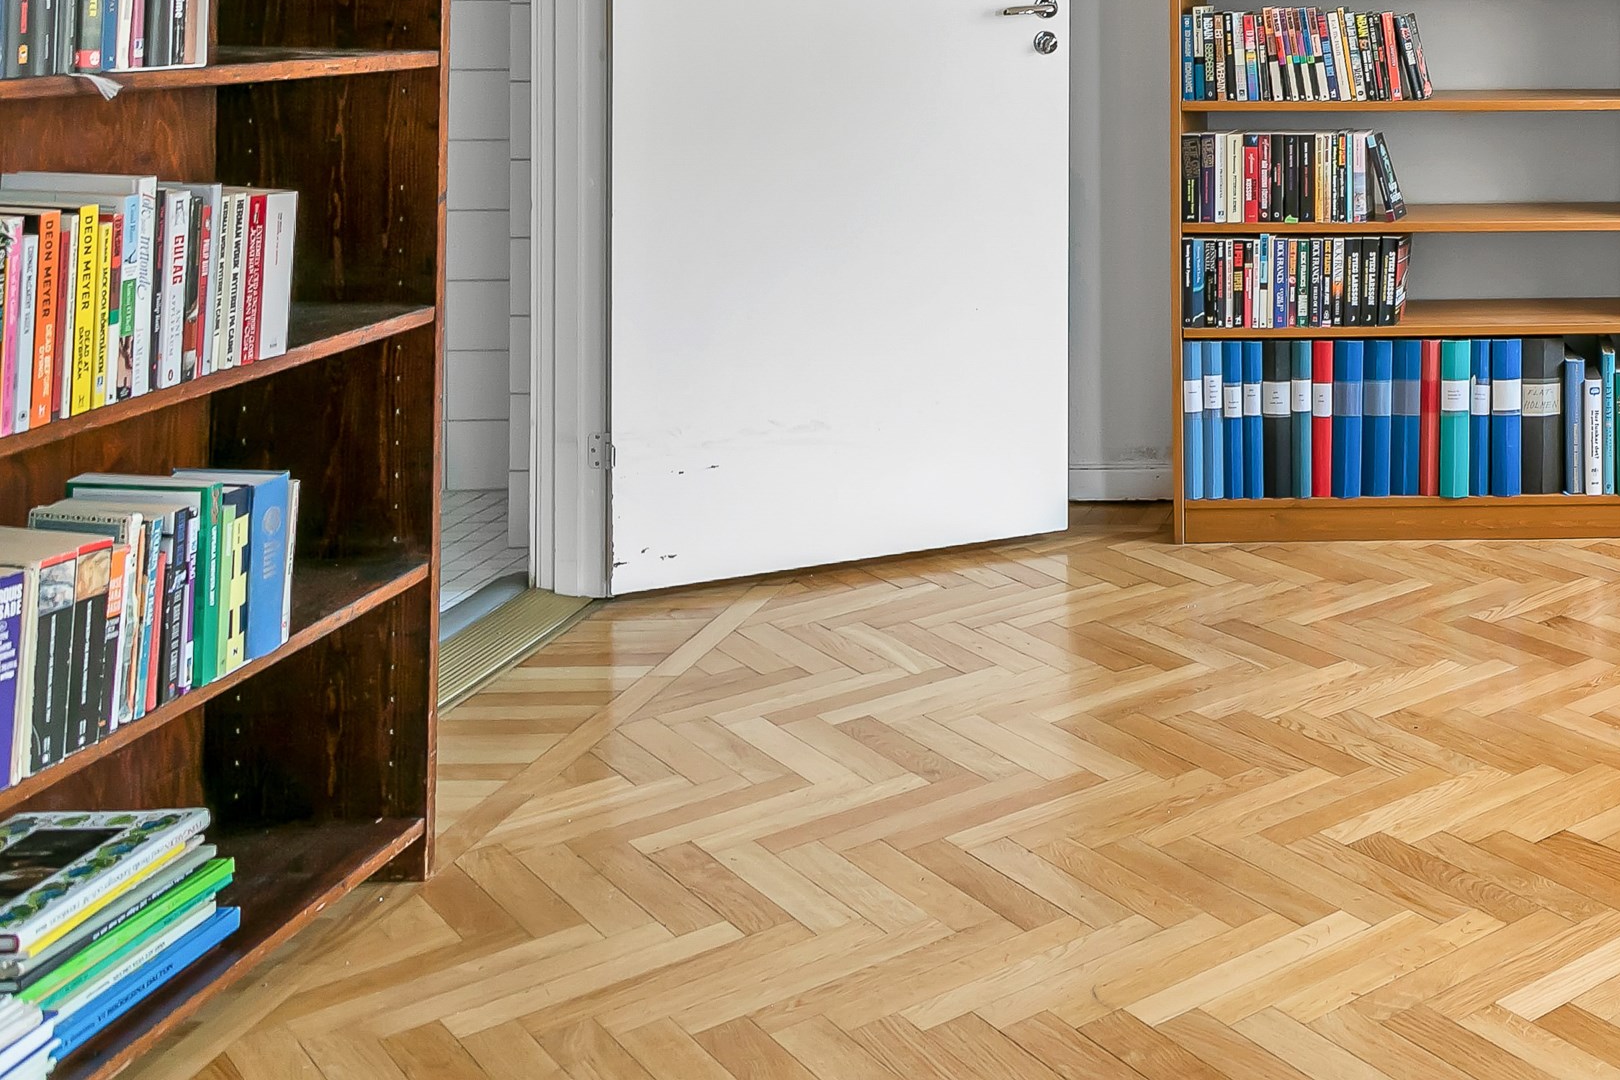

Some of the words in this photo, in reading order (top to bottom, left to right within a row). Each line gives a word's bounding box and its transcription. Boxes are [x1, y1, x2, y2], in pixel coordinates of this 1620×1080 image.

[83, 215, 93, 255] DEON
[234, 199, 244, 239] HERMAN
[44, 220, 54, 262] DEON
[233, 241, 242, 269] WOUK
[172, 235, 185, 285] GULAG
[41, 267, 53, 318] MEYER
[80, 261, 92, 311] MEYER
[1368, 274, 1376, 305] LARSSON
[1386, 273, 1394, 305] LARSSON
[44, 324, 52, 353] DEAD
[83, 330, 91, 358] DEAD
[42, 356, 50, 397] BEFORE
[82, 361, 89, 372] AT
[1523, 399, 1559, 410] HOLMEN
